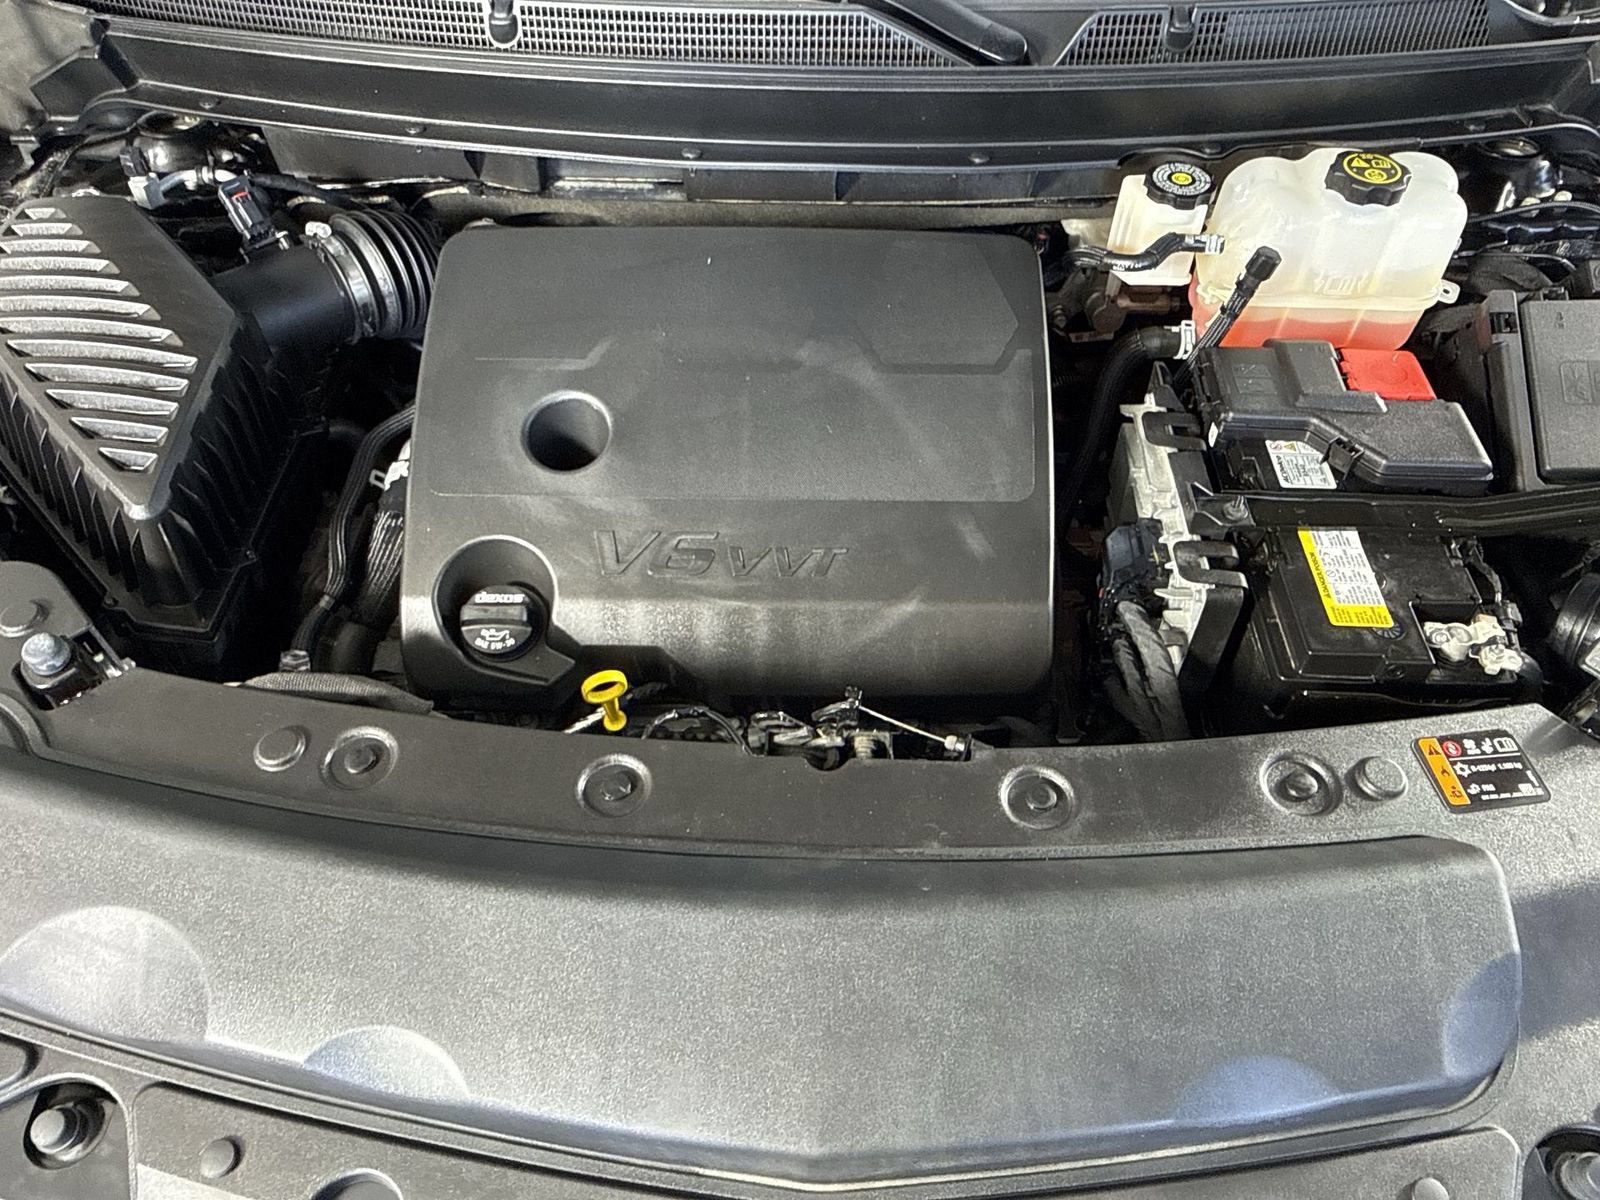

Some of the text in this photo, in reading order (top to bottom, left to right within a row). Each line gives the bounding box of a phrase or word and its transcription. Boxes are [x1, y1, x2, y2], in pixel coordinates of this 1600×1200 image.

[594, 530, 849, 577] V6 VVT
[474, 591, 525, 604] dexos
